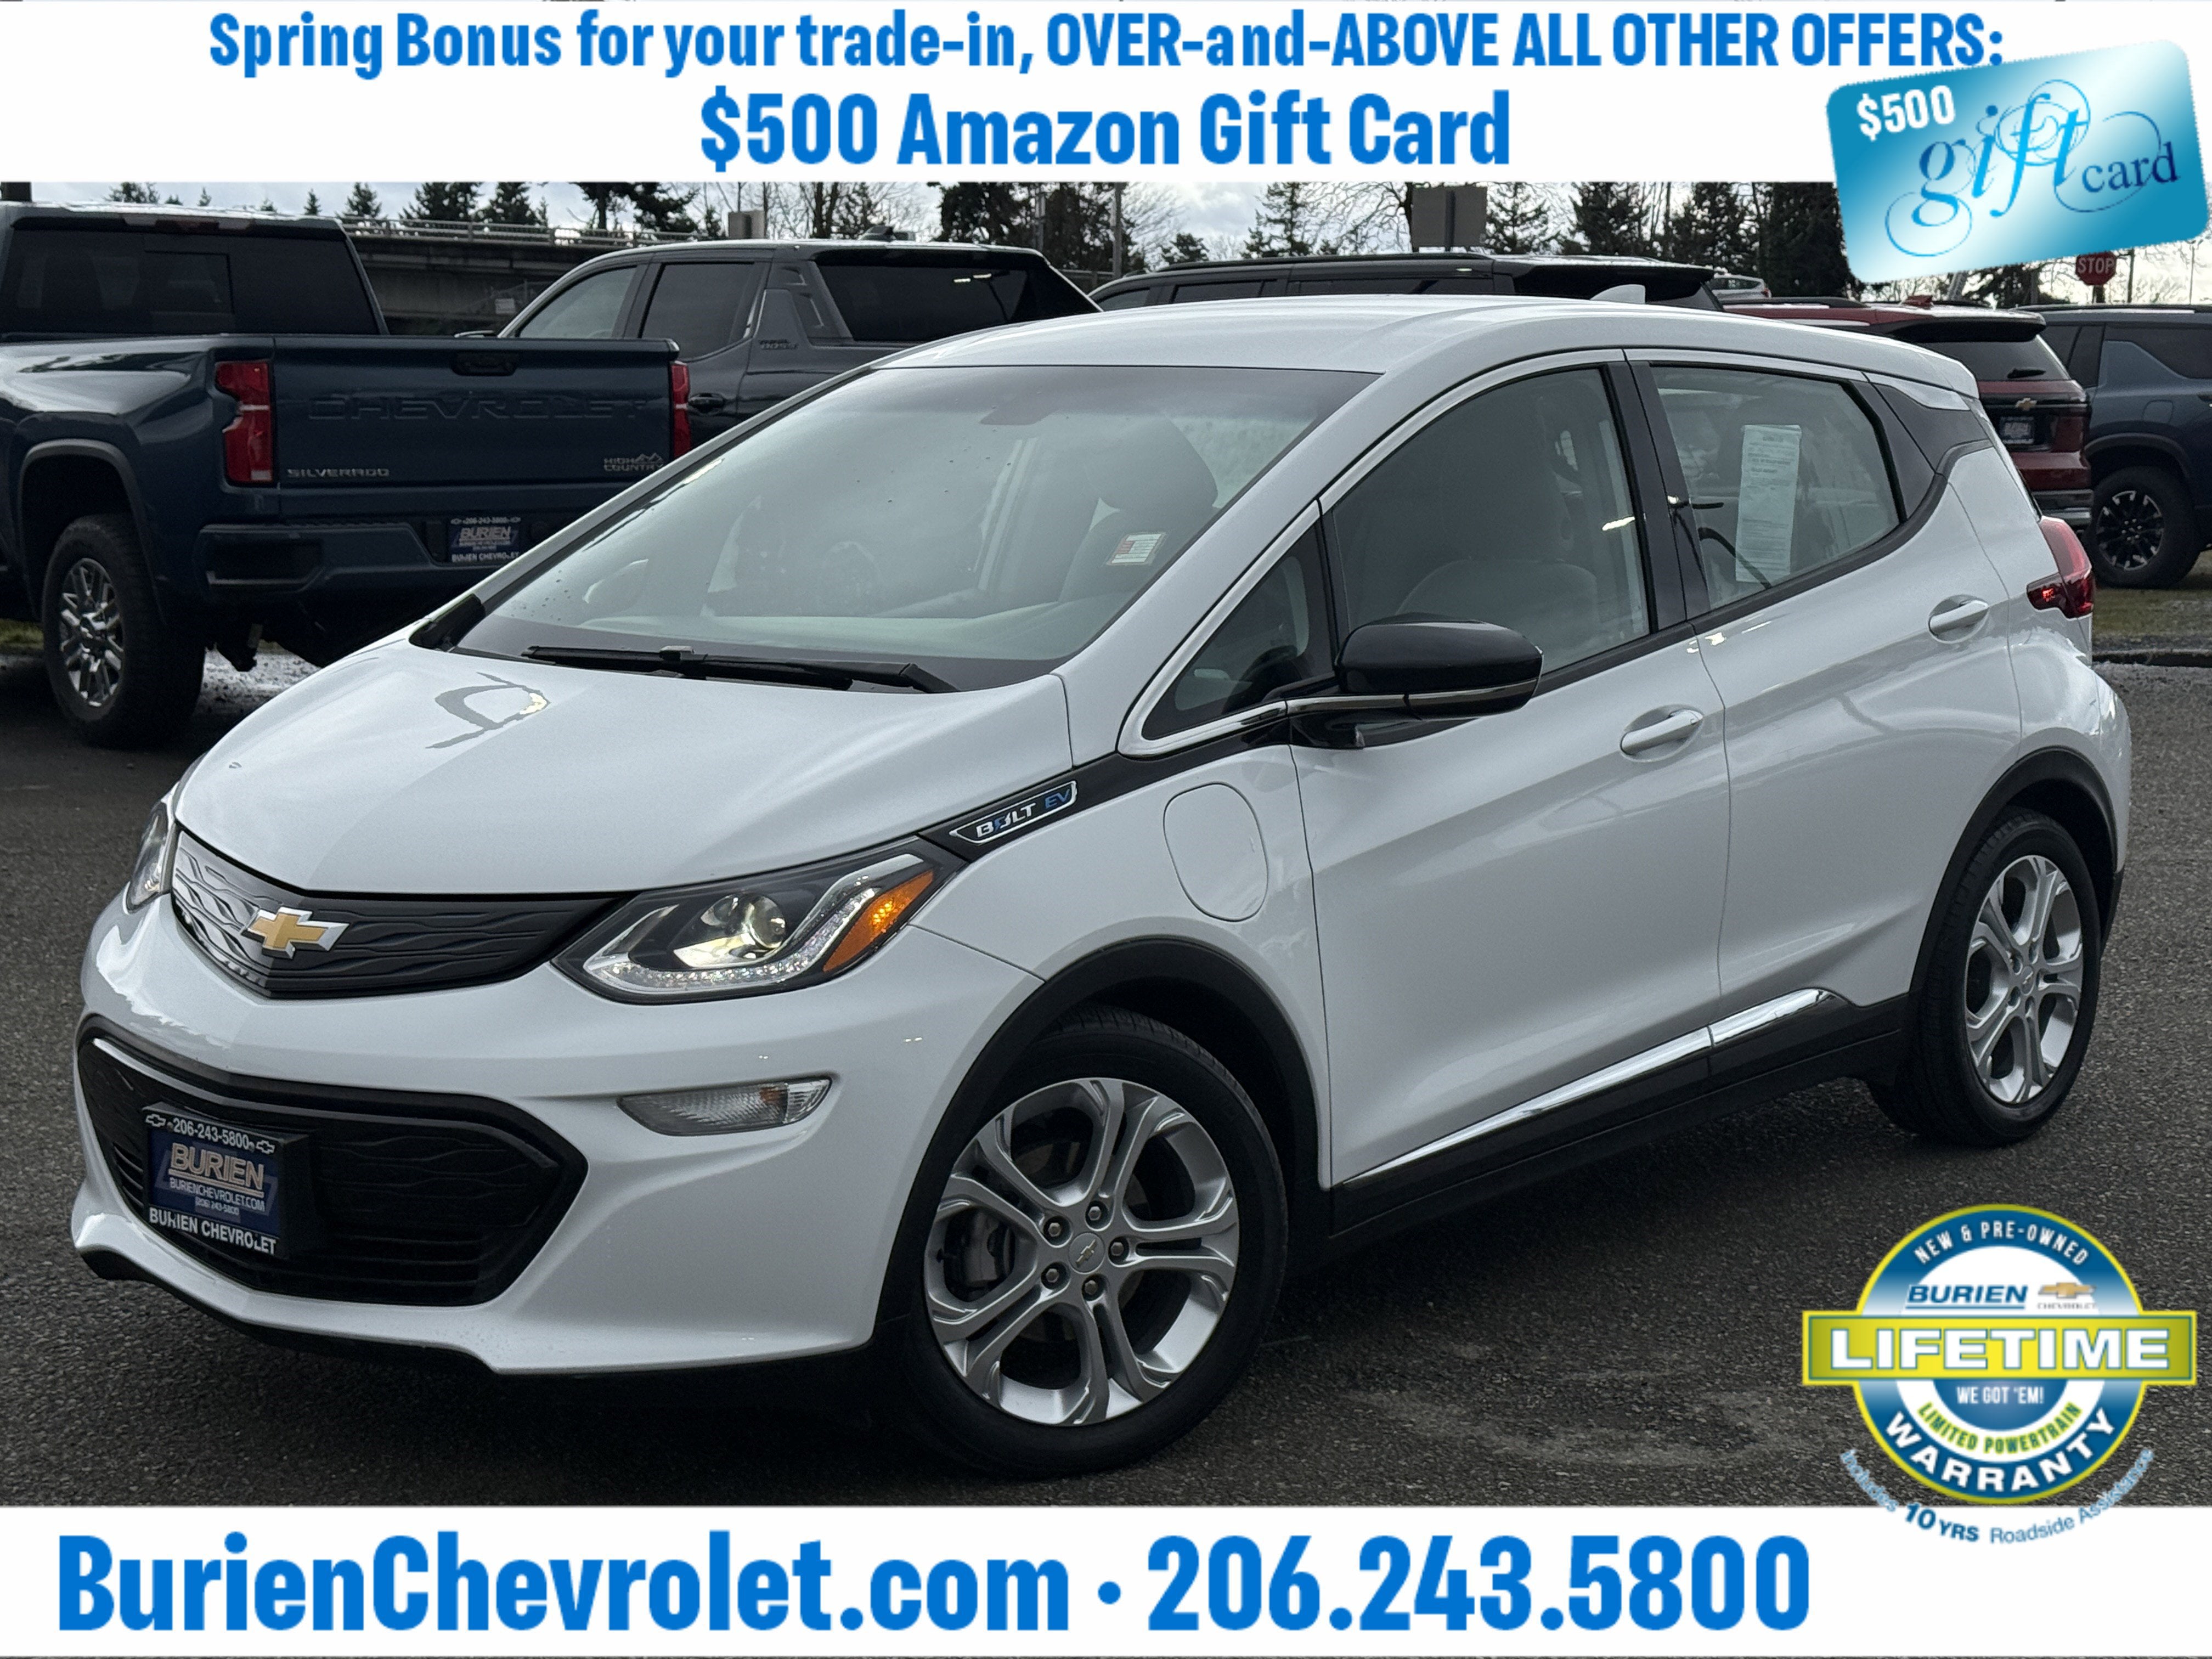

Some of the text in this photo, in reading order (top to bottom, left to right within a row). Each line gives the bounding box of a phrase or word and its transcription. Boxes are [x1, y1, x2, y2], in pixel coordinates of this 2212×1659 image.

[2077, 257, 2115, 274] STOP
[287, 468, 390, 478] SILVERADO
[460, 526, 511, 539] BURIEN
[975, 788, 1070, 838] BOLT EV
[173, 1117, 250, 1150] 206-243-5800
[170, 1142, 265, 1190] BURIEN
[169, 1177, 266, 1212] BURIENCHEVROLET.COM
[201, 1220, 277, 1256] CHEVROLET
